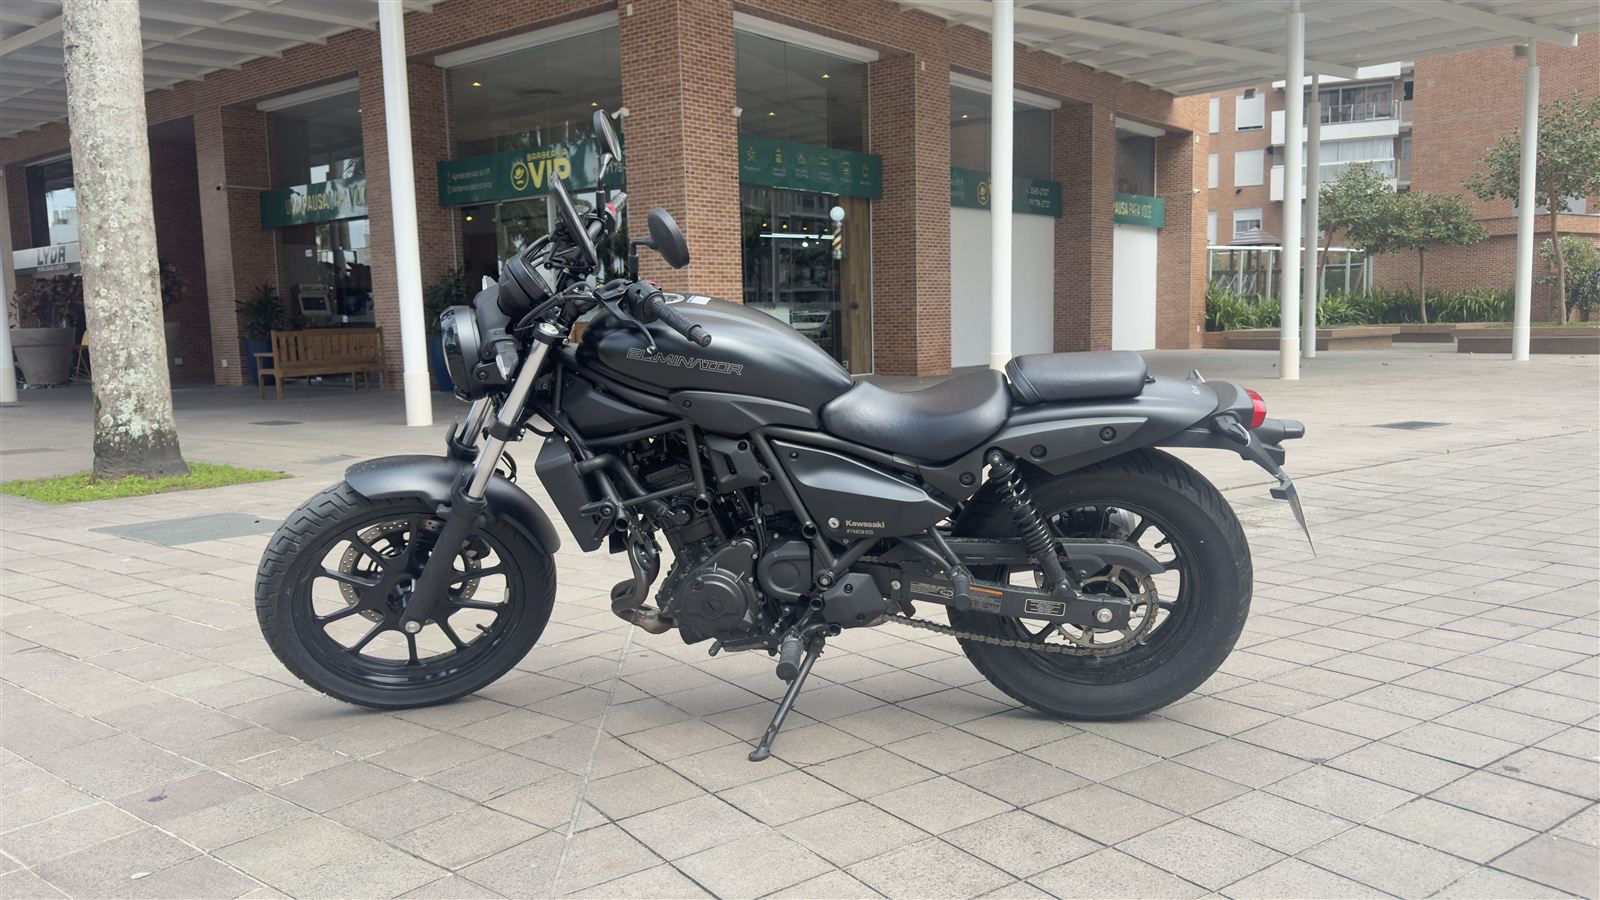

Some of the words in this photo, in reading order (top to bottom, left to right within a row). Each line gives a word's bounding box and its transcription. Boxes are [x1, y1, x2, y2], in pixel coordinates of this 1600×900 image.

[527, 157, 572, 189] VIP
[302, 191, 330, 213] PAUSA
[1114, 201, 1128, 216] AUSA
[626, 347, 744, 376] ELIMINATOR
[845, 519, 886, 529] Kawasaki
